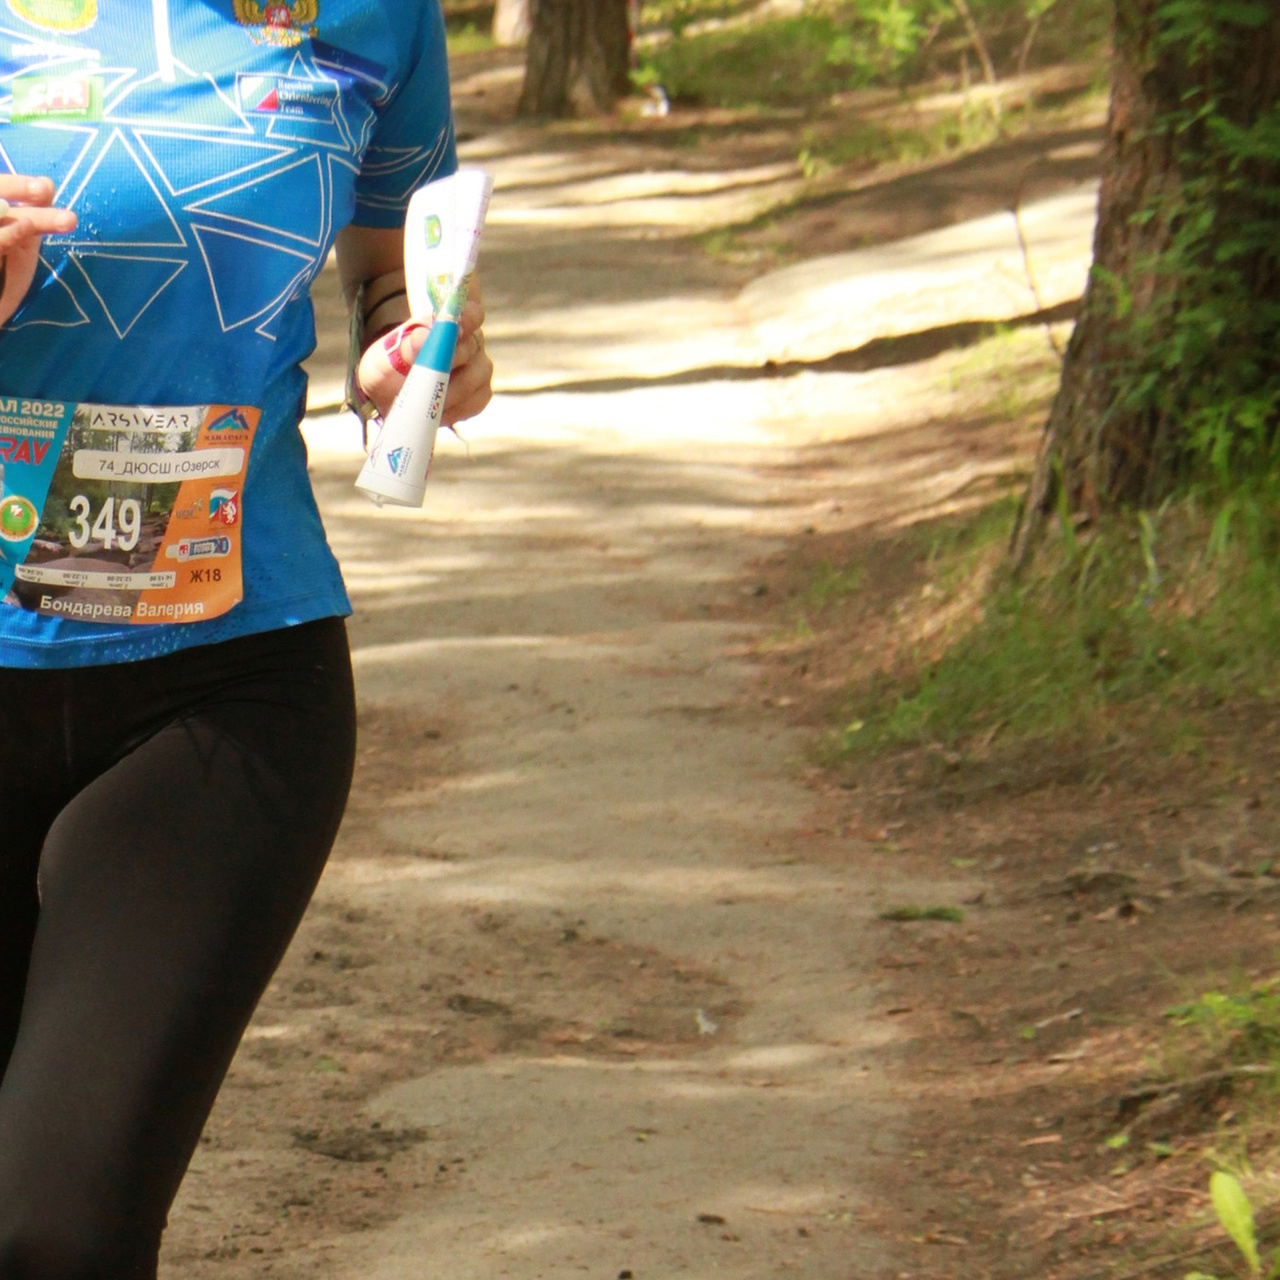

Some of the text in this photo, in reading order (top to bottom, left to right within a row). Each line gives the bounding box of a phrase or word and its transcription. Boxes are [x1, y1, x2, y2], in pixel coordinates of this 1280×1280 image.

[278, 78, 314, 91] Russian
[278, 90, 331, 108] Orienteering
[279, 102, 304, 115] Team
[21, 401, 65, 418] 2022
[92, 412, 189, 430] ARSWEAR
[99, 458, 220, 476] 74_ДЮСШ г.Озерск
[68, 494, 141, 552] 349
[190, 568, 222, 583] Ж18
[40, 595, 204, 618] Бондарева Валерия
